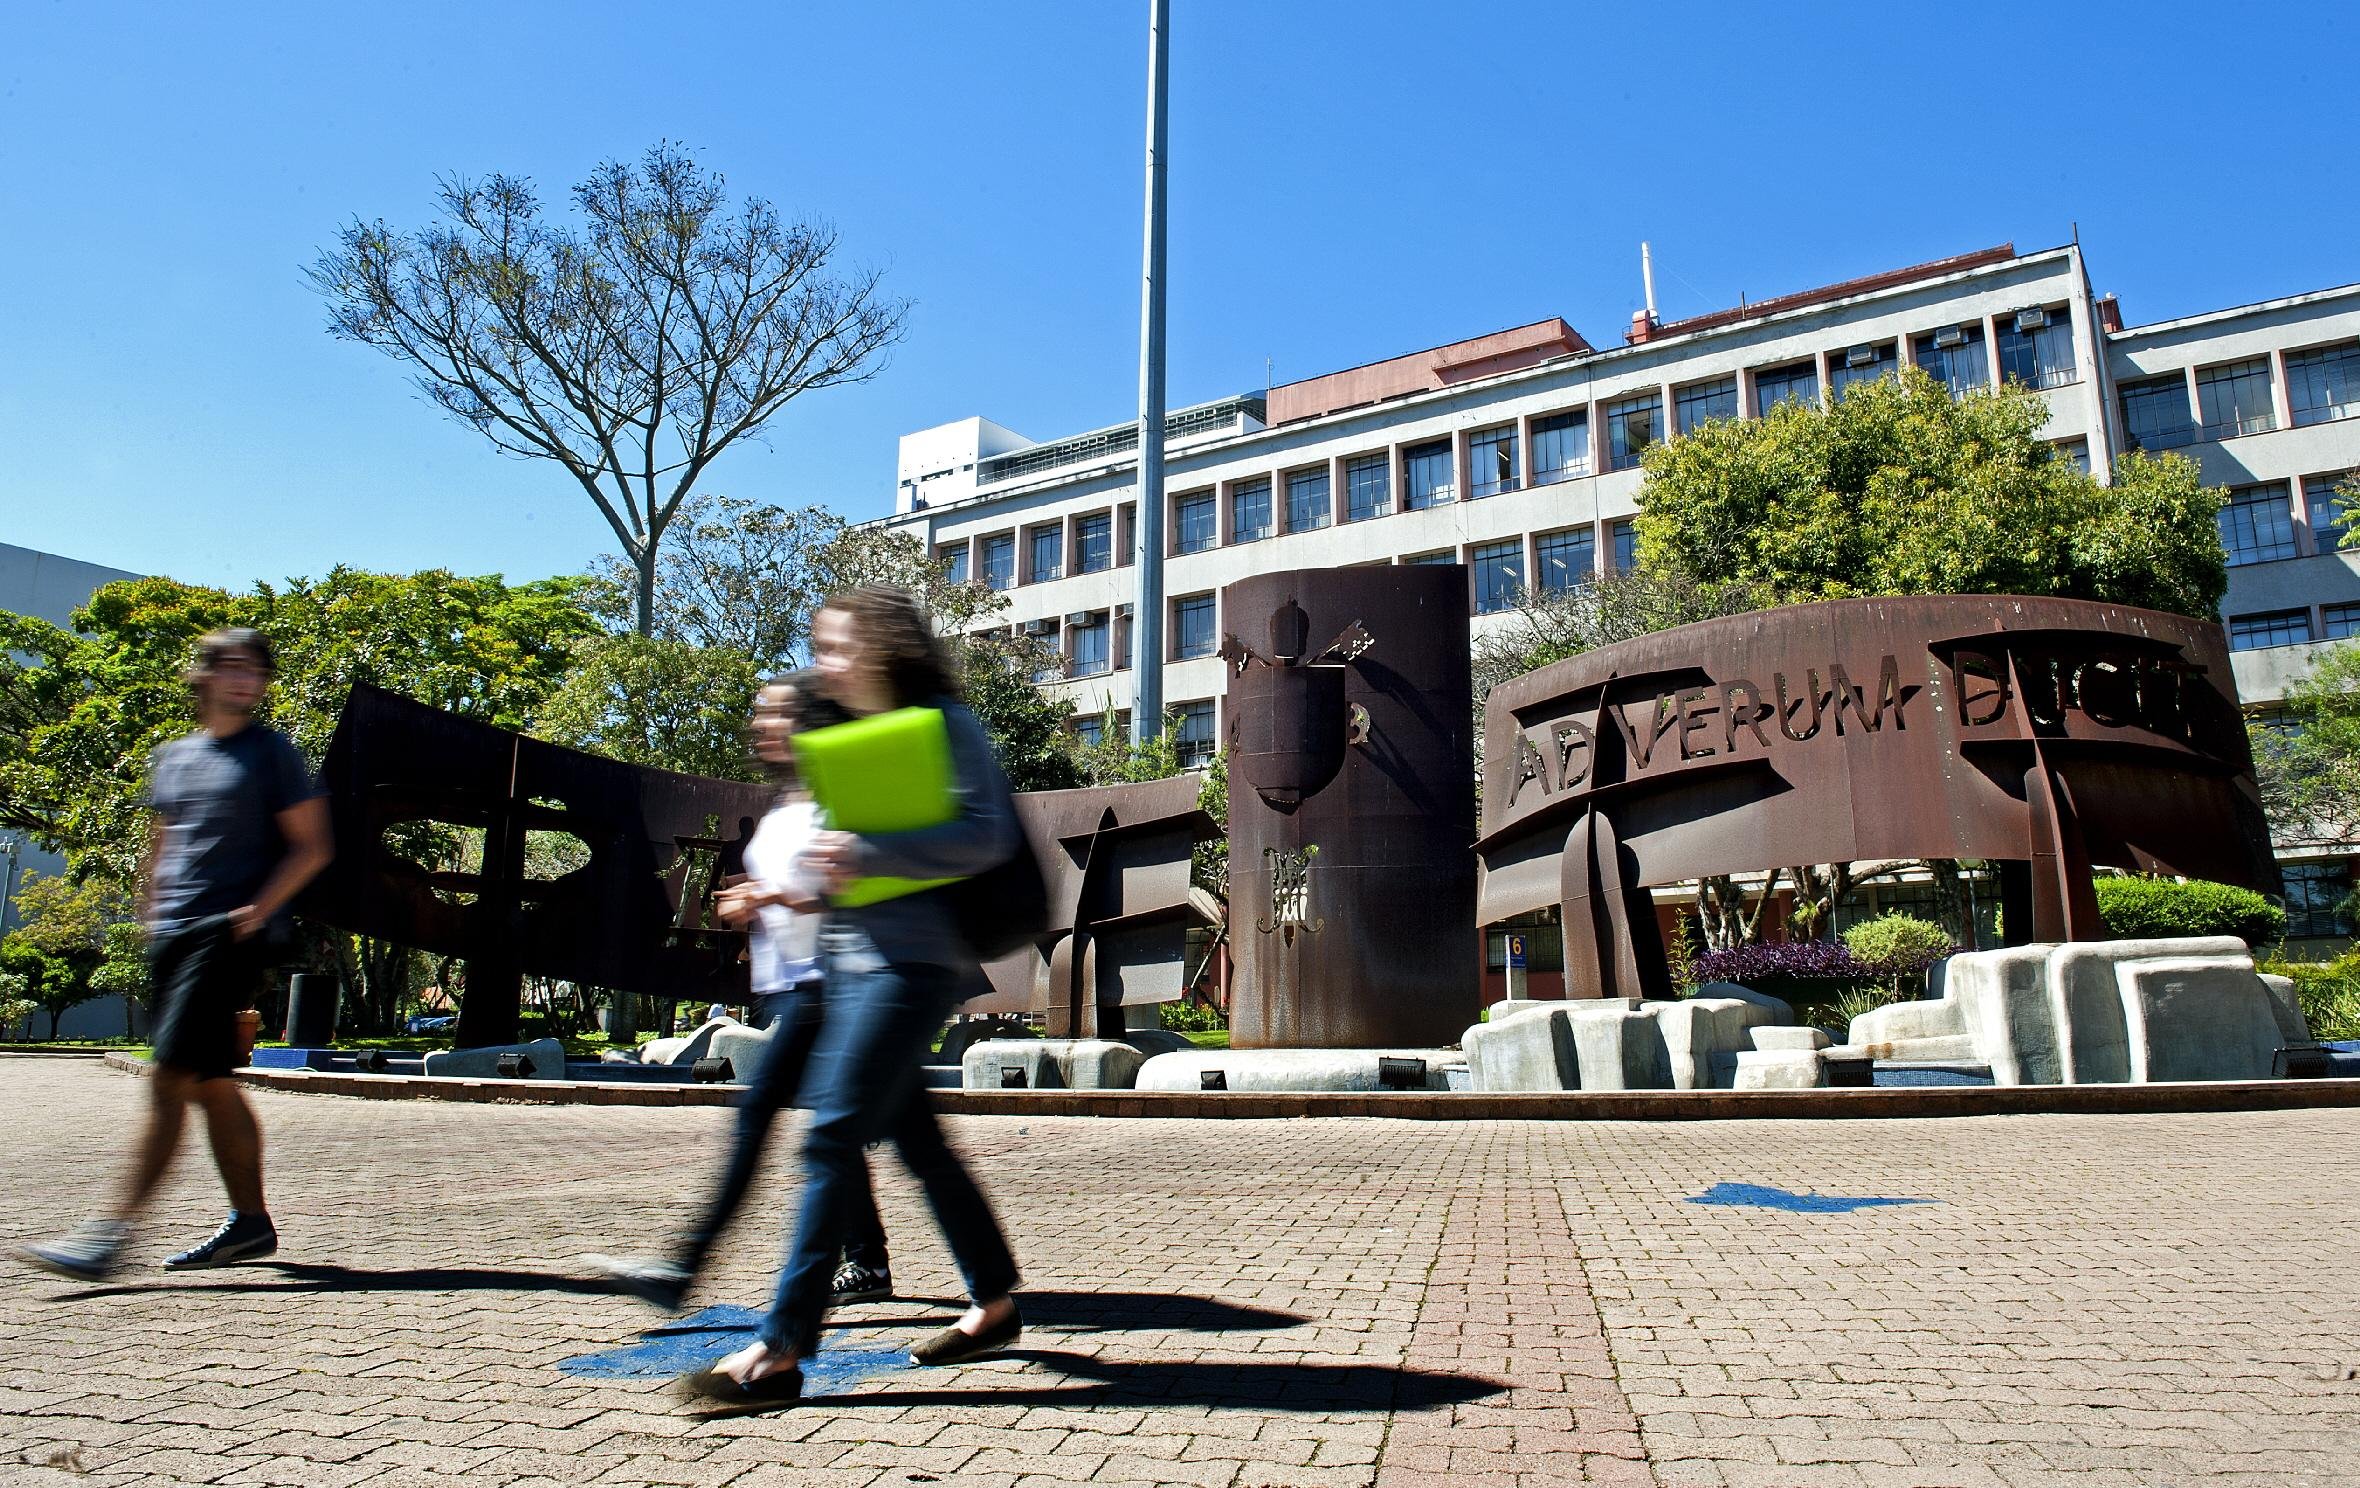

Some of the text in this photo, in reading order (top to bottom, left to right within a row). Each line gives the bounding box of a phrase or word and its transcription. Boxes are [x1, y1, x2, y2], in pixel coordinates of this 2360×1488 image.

[1508, 649, 2208, 808] AD VERUM DUCIT
[1512, 937, 1522, 955] 6
